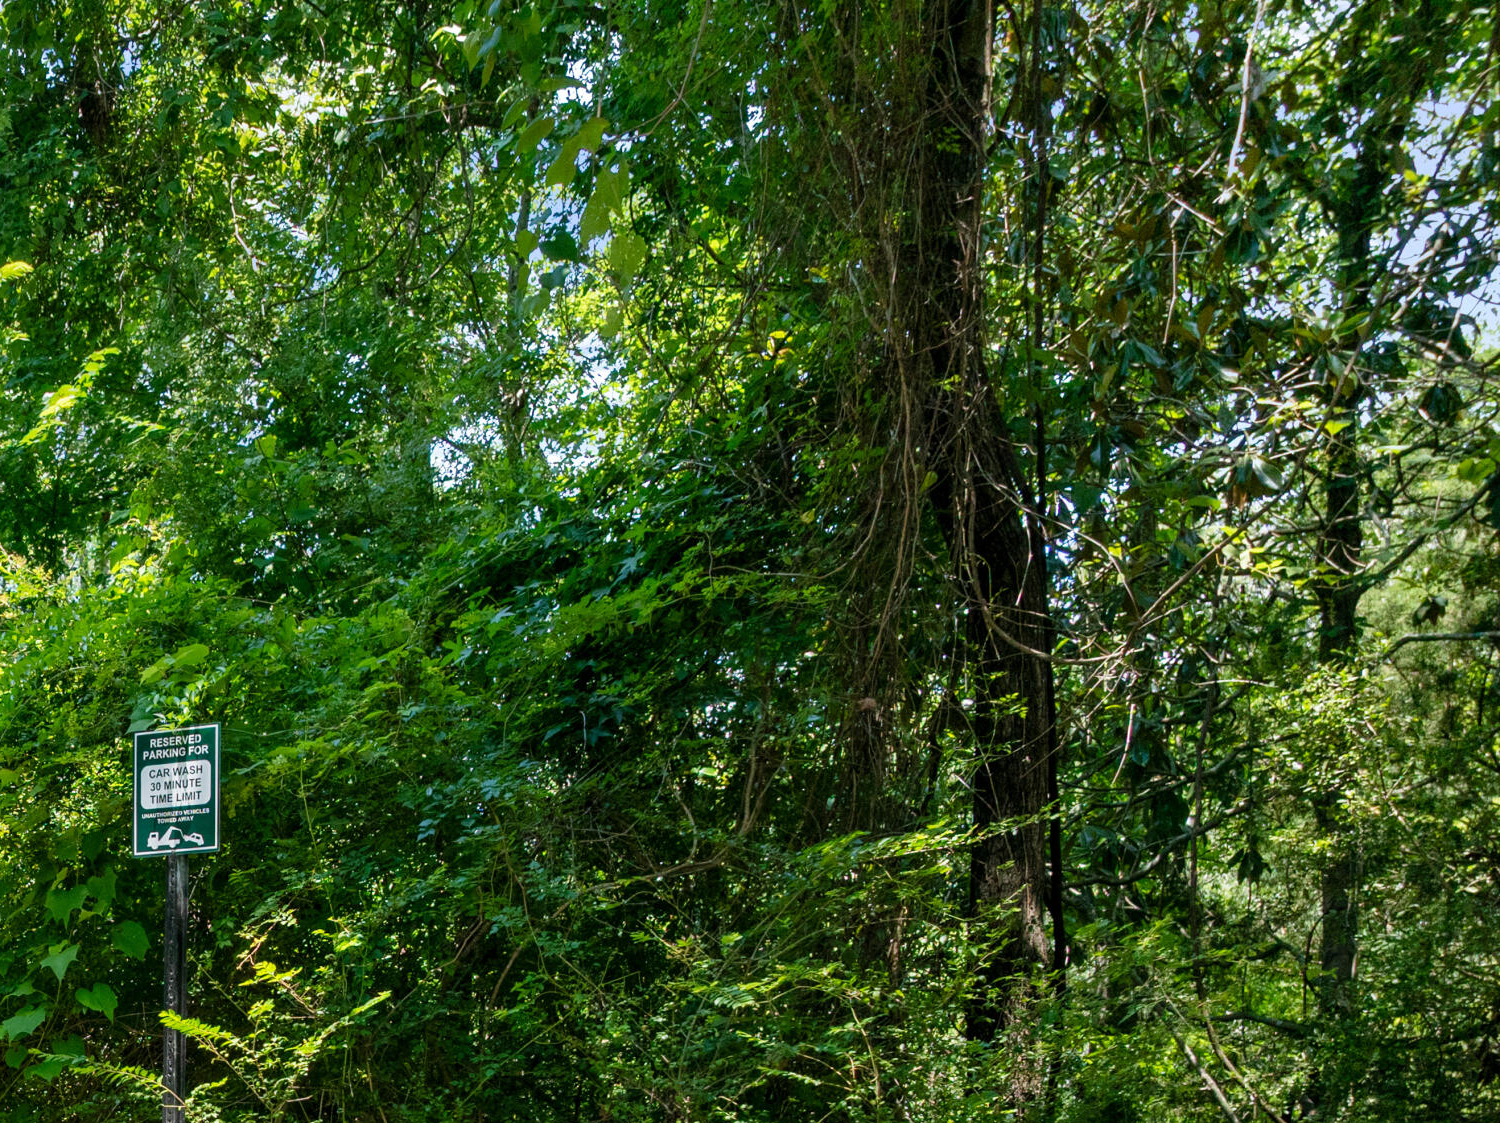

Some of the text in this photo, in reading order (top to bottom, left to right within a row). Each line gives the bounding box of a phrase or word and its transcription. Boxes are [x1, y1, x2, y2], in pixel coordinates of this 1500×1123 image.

[150, 734, 202, 748] RESERVED
[143, 744, 209, 760] PARKING FOR
[149, 765, 203, 779] CAR WASH
[150, 778, 202, 791] 30 MINUTE
[150, 791, 202, 804] TIME LIMIT
[141, 808, 210, 819] UNAUTHORIZED VEHICLES
